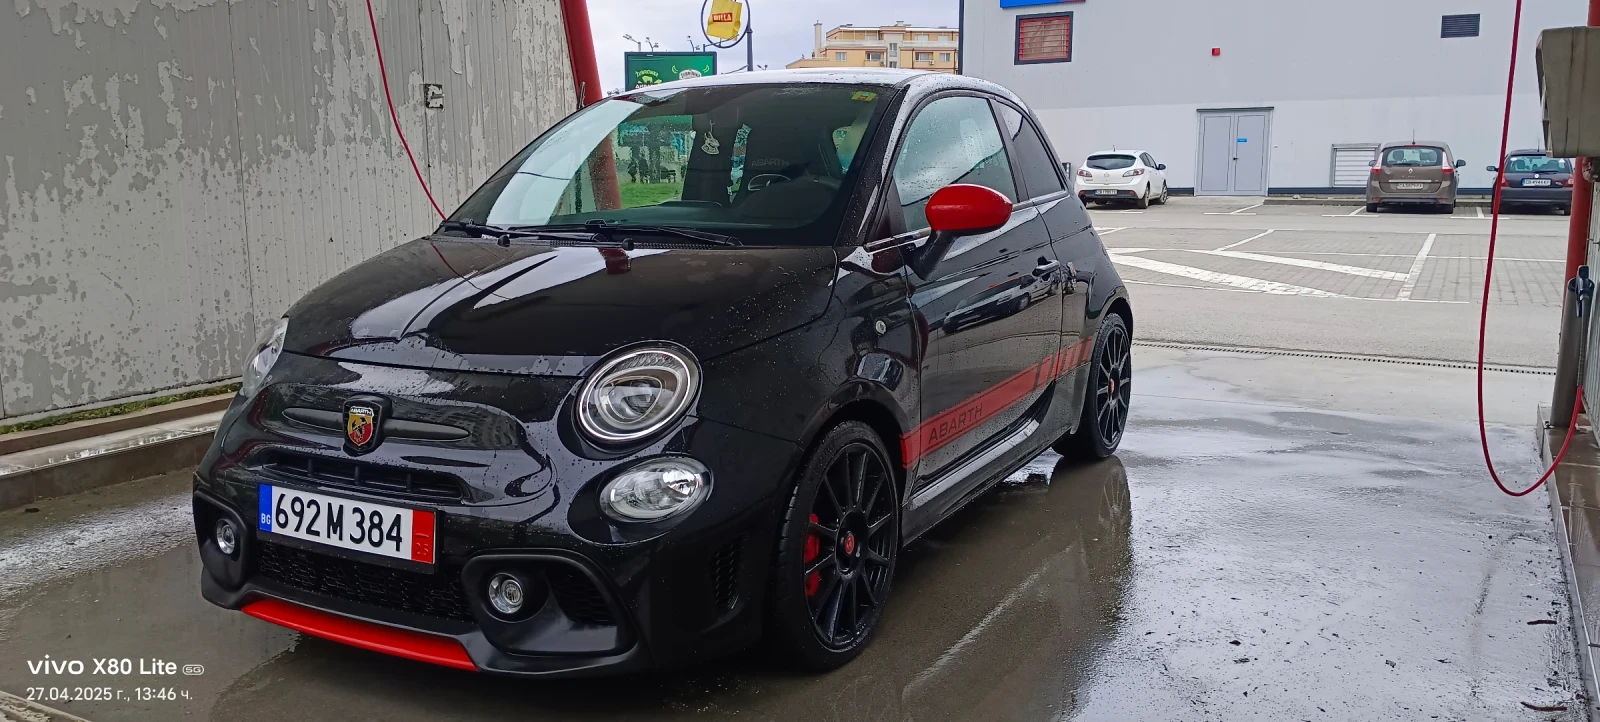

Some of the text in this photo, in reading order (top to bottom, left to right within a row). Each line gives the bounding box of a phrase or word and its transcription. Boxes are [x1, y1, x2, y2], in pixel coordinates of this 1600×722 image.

[713, 13, 732, 21] BILLA
[751, 158, 790, 167] ABARTH
[350, 407, 372, 415] ABARTH
[928, 403, 984, 443] ABARTH
[261, 512, 271, 525] BG
[275, 493, 403, 552] 692 M 384
